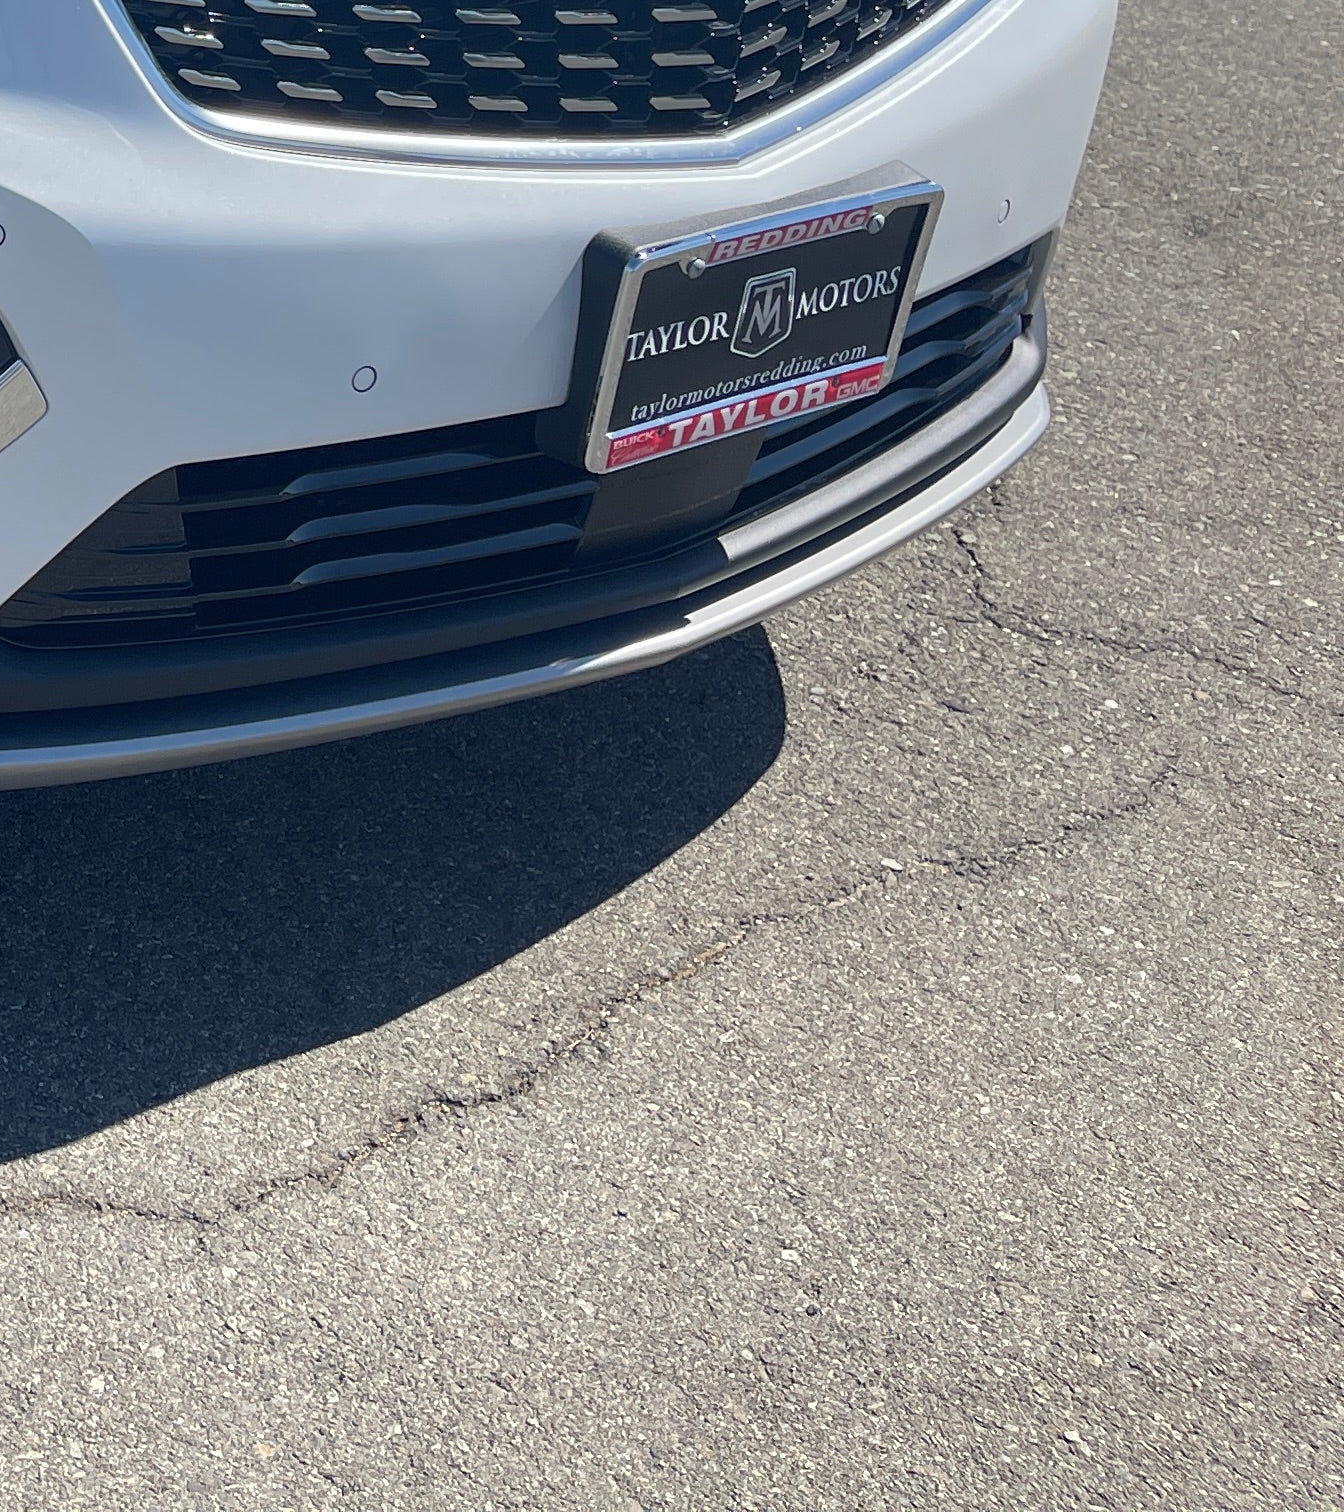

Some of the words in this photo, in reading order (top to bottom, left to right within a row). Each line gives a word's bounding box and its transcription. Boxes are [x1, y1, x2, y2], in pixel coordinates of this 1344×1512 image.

[714, 208, 868, 261] REDDING
[627, 311, 730, 363] TAYLOR
[795, 265, 901, 321] MOTORS
[631, 345, 867, 422] taylormotorsredding.com
[668, 379, 829, 448] TAYLOR
[836, 374, 881, 400] GMC
[613, 429, 657, 450] BUICK
